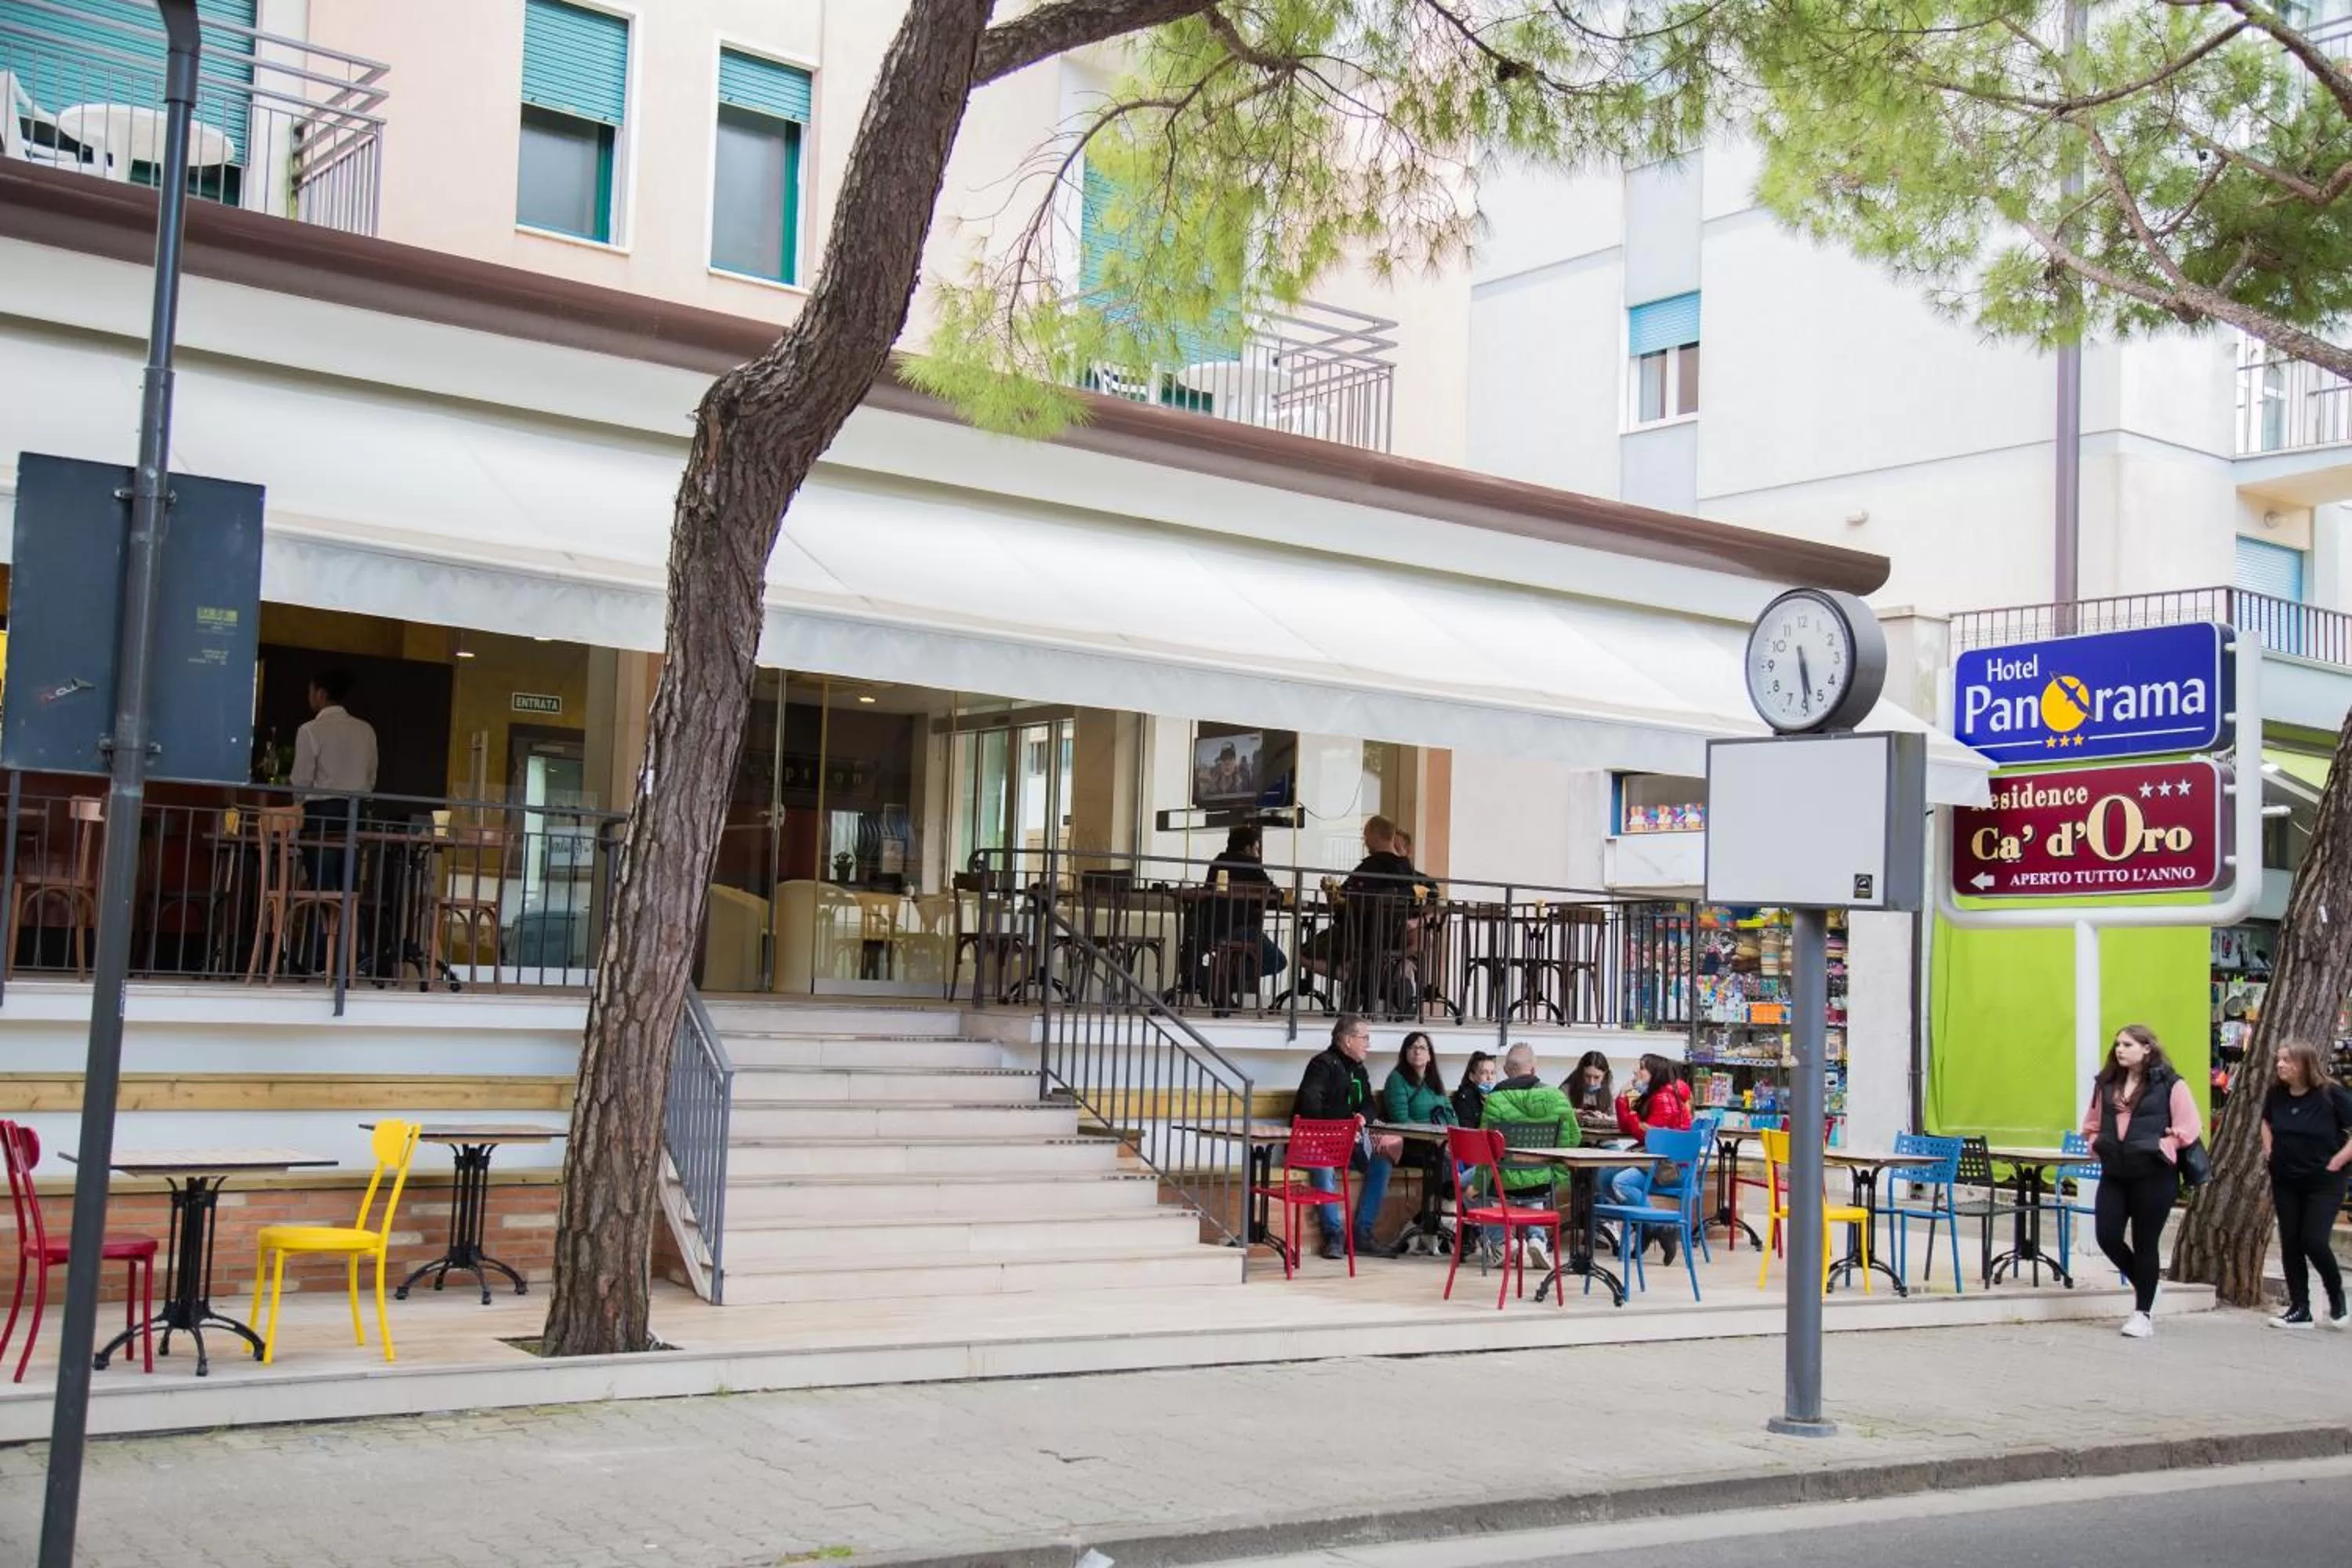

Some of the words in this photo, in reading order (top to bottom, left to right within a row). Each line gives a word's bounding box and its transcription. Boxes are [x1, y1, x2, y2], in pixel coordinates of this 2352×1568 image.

[1797, 615, 1807, 628] 12
[1783, 624, 1791, 637] 11
[1772, 639, 1787, 653] 10
[1827, 633, 1835, 647] 2
[1768, 659, 1775, 672] 9
[1833, 652, 1840, 665] 3
[1986, 653, 2038, 682] Hotel
[1773, 680, 1780, 692] 8
[1828, 673, 1835, 685] 4
[1787, 692, 1794, 706] 7
[1817, 689, 1824, 702] 5
[516, 695, 558, 711] ENTRATA
[1971, 781, 2089, 811] esidence
[1970, 824, 2034, 861] Ca'
[2045, 793, 2194, 862] d'Oro
[2009, 872, 2071, 887] APERTO
[2074, 869, 2129, 884] TUTTO
[2132, 866, 2196, 880] L'ANNO
